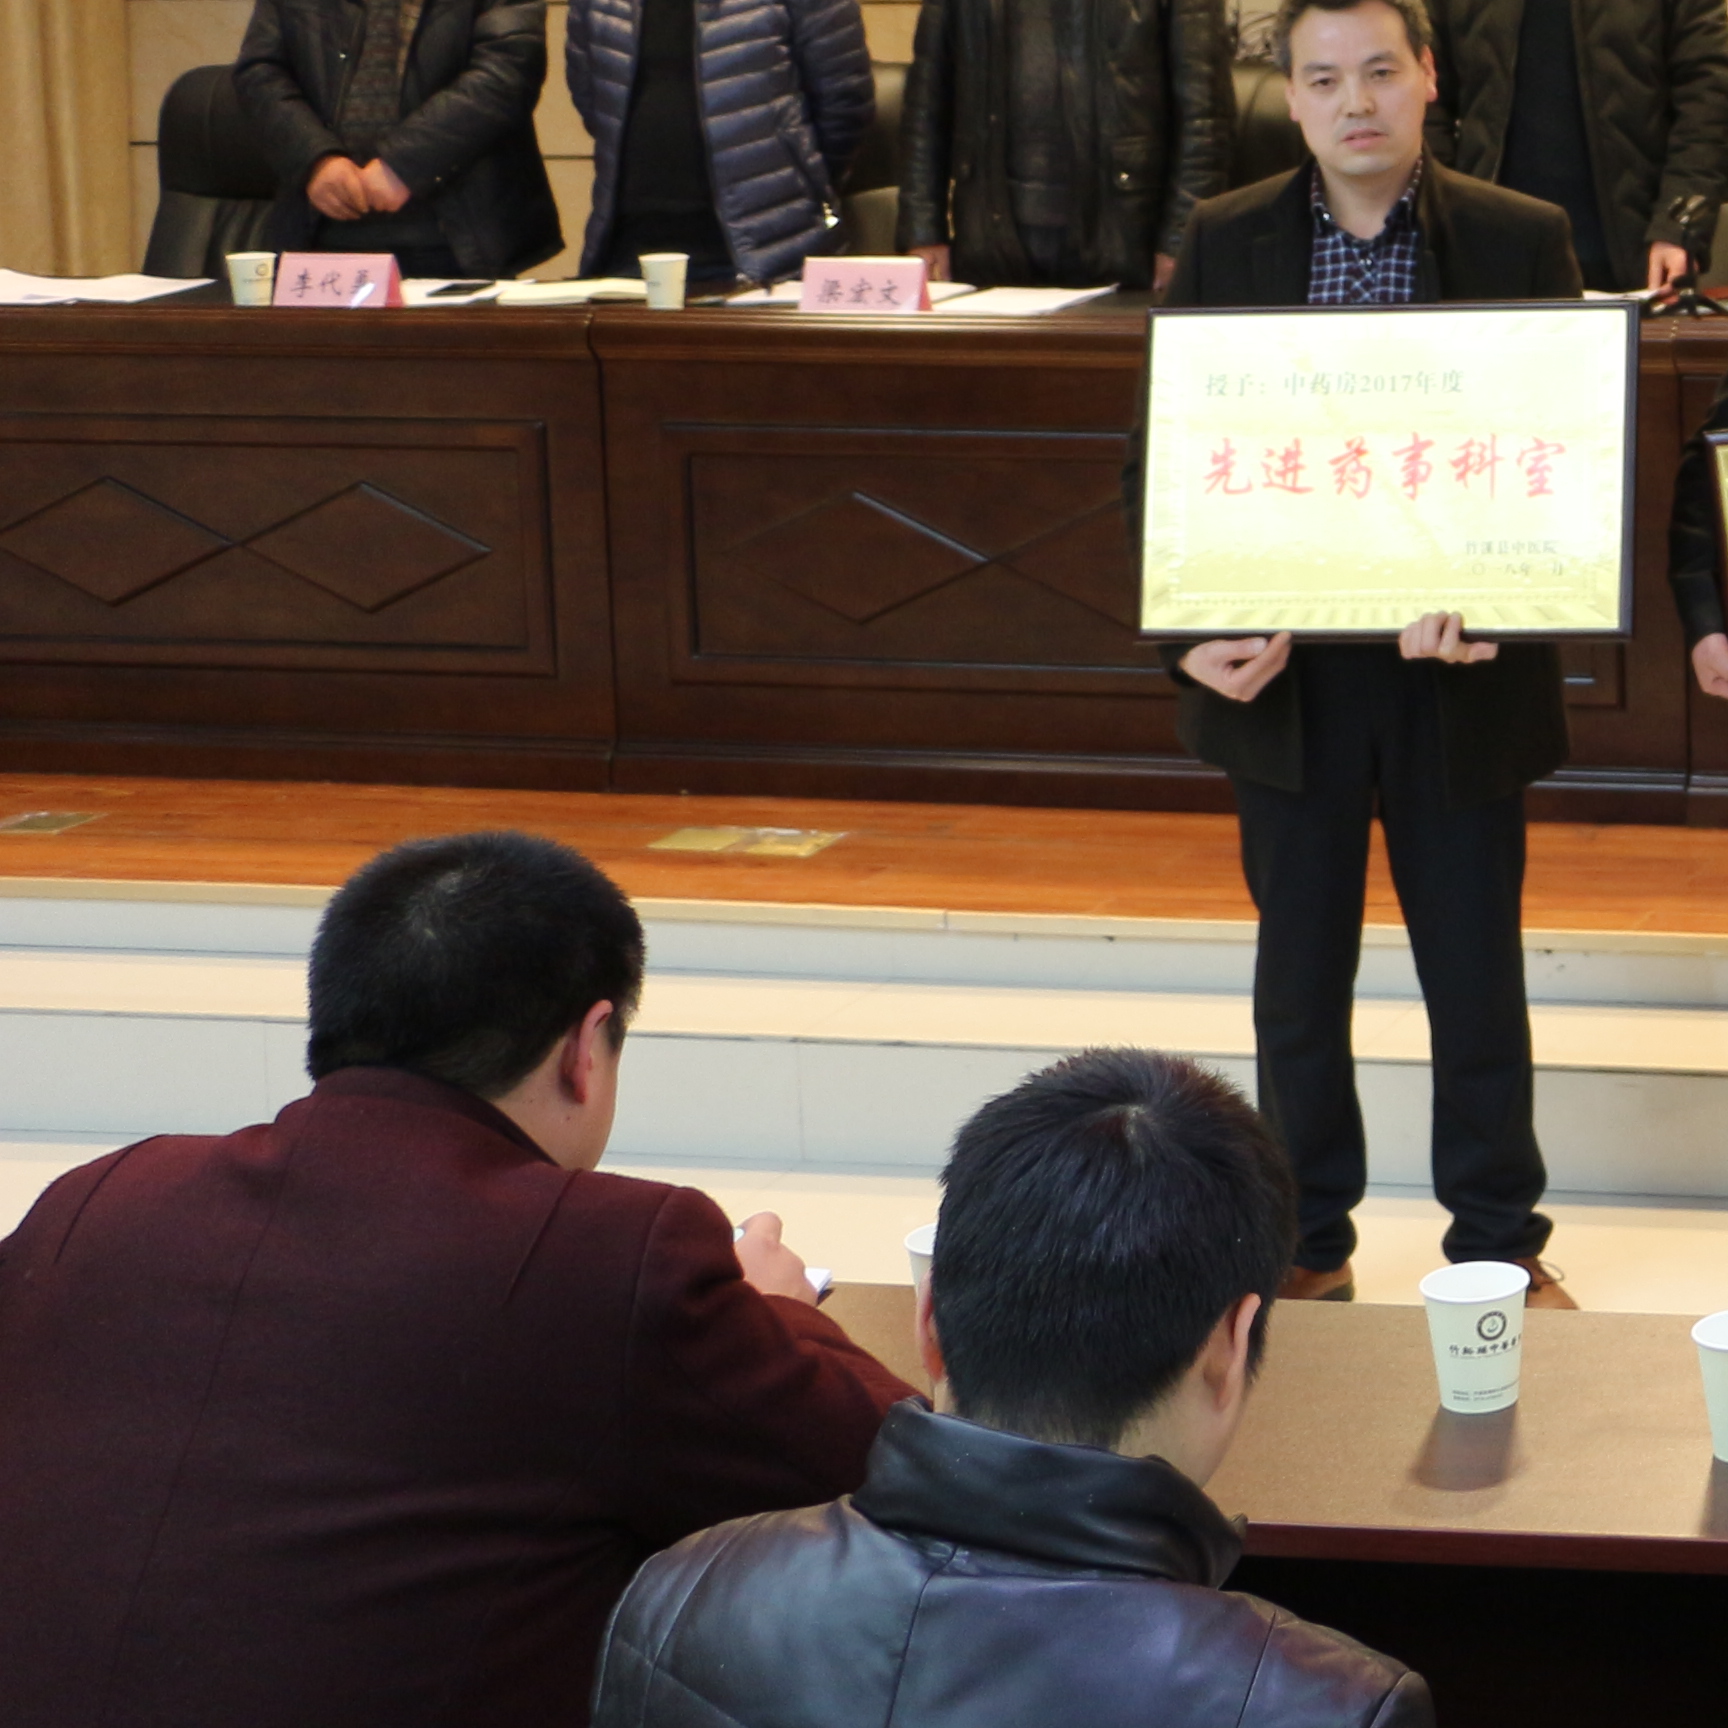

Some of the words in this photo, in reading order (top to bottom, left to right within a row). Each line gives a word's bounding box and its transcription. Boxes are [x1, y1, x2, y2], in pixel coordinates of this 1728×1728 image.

[1204, 432, 1567, 500] 先进药事科室
